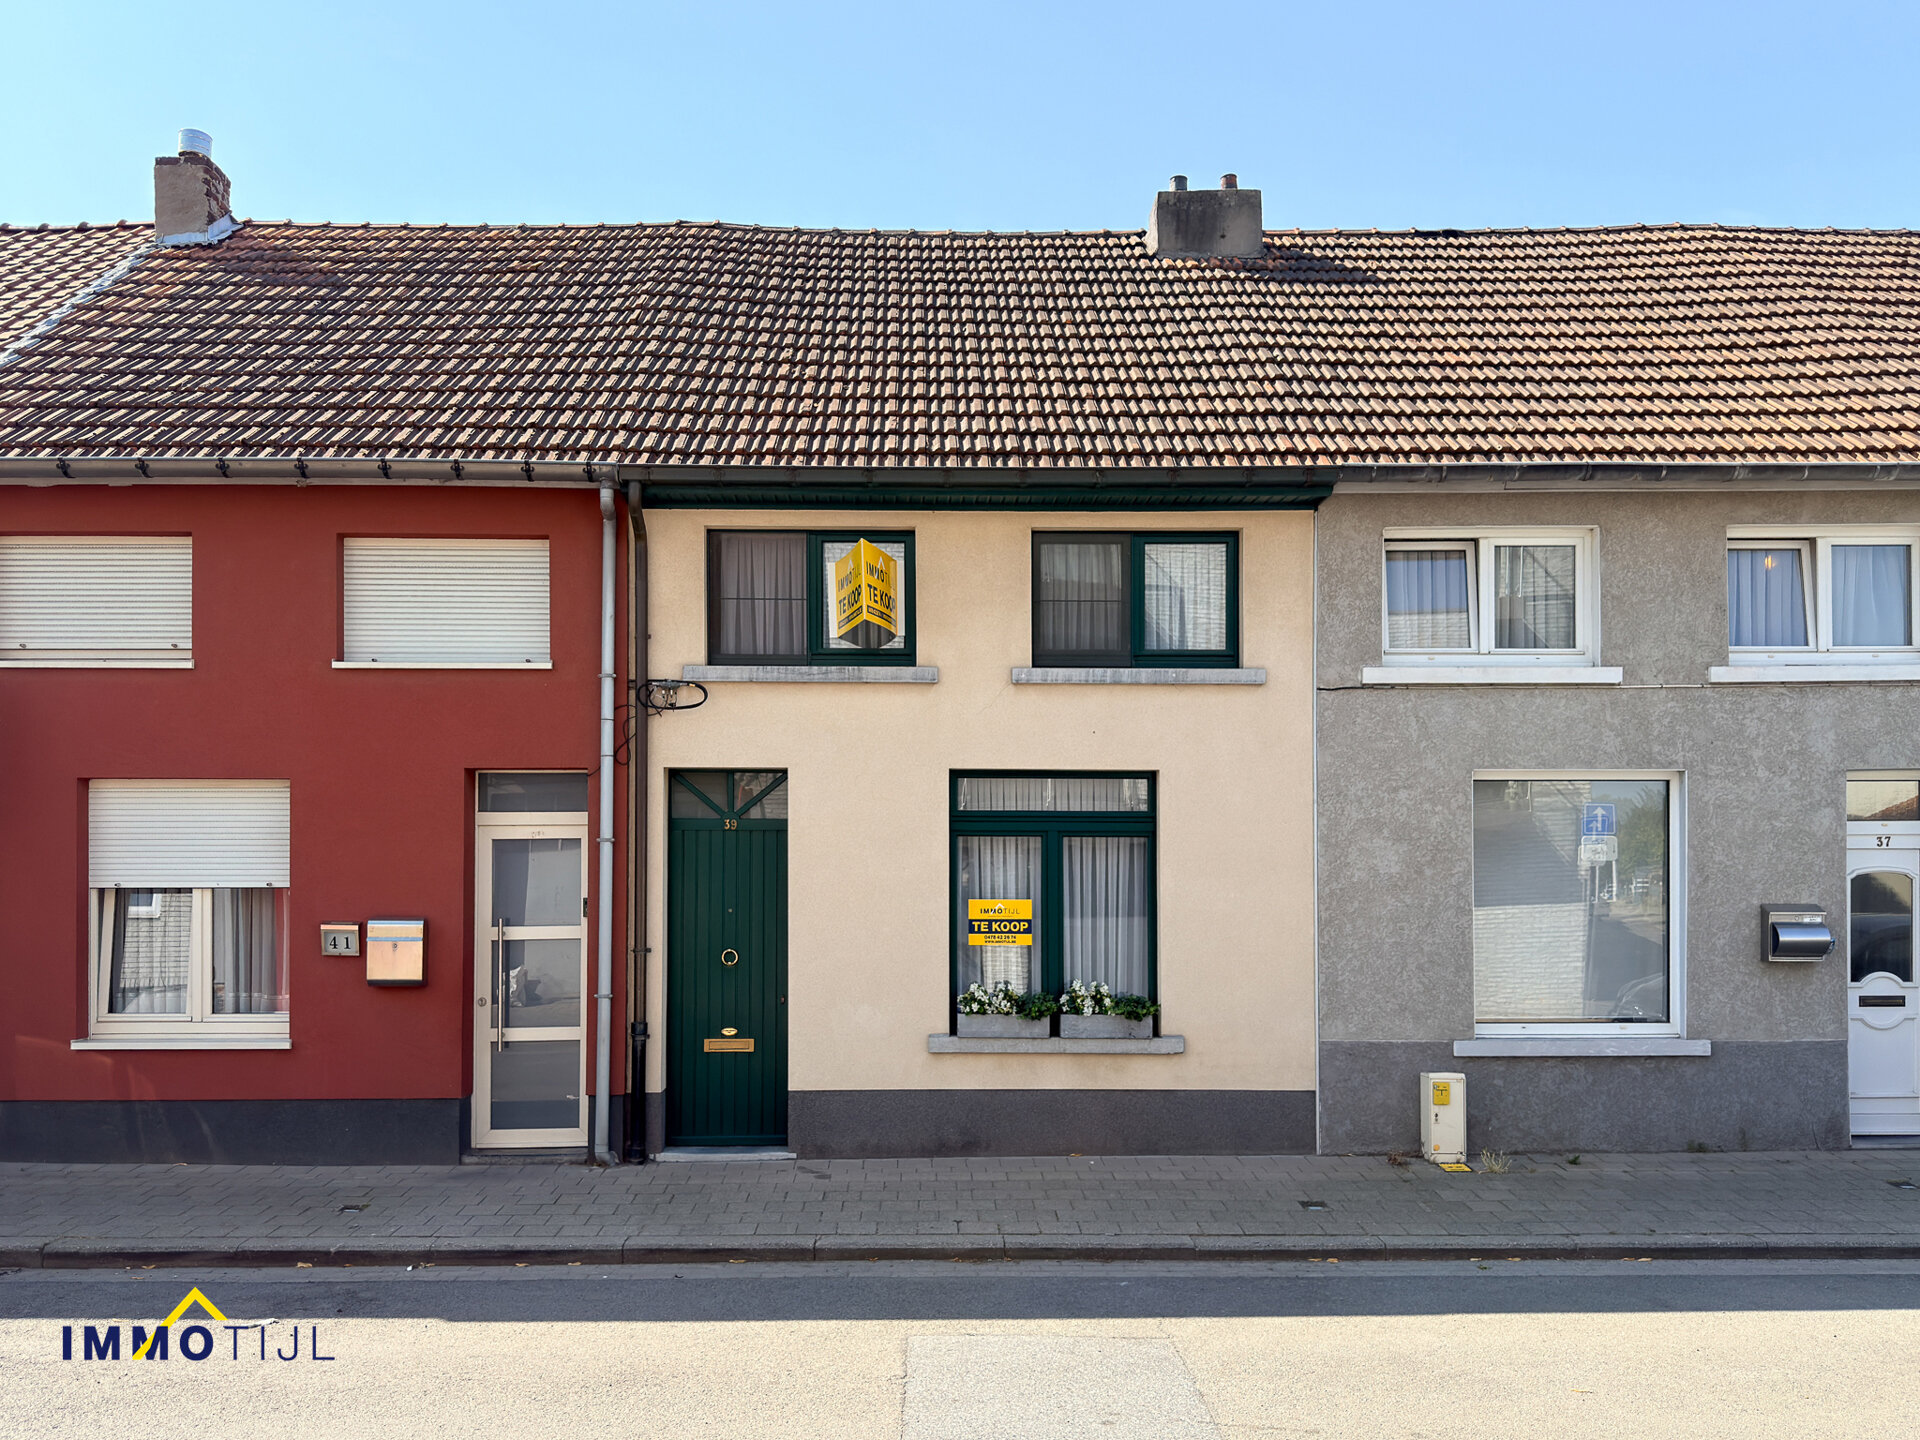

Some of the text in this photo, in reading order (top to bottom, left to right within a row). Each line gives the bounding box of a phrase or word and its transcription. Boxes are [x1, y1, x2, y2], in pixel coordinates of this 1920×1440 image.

[839, 596, 847, 616] TE
[847, 584, 861, 610] KOOP
[867, 583, 896, 613] TE KOOP
[724, 819, 737, 830] 39
[1876, 836, 1891, 847] 37
[972, 921, 1029, 932] TE KOOP
[329, 936, 351, 949] 41
